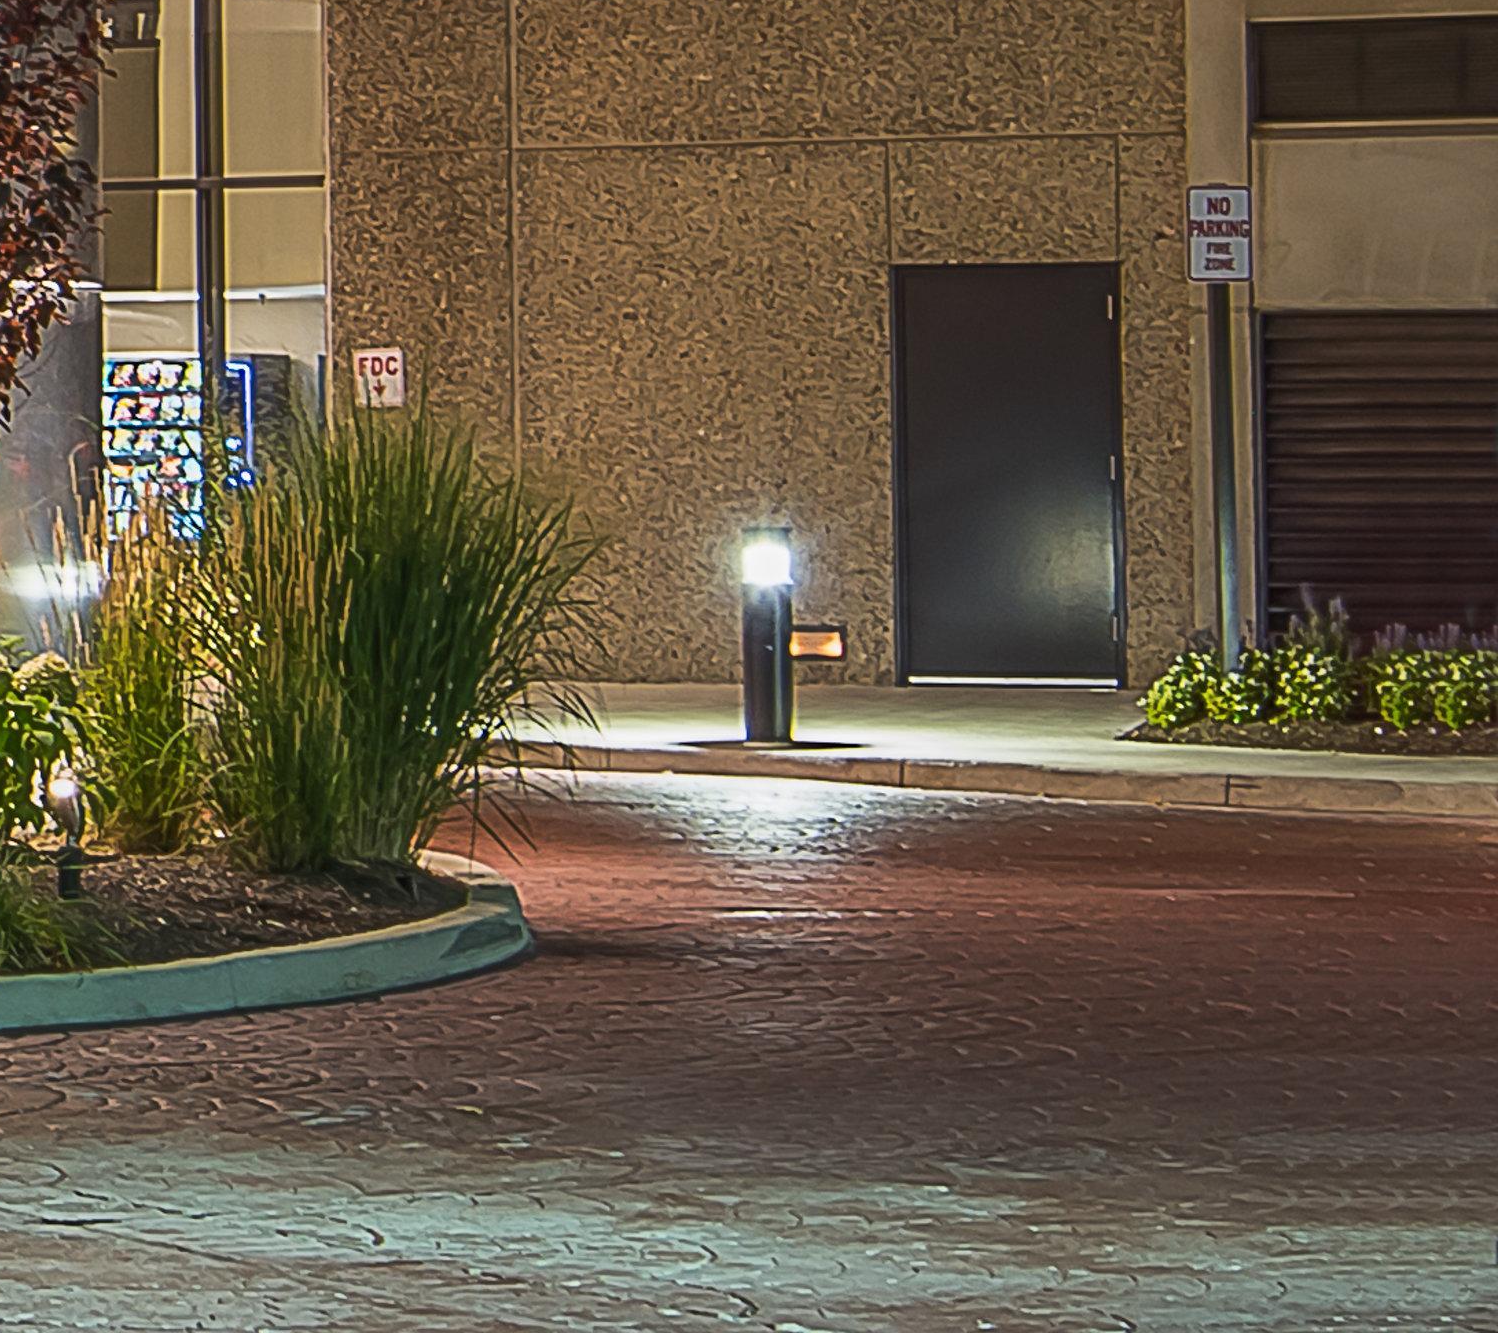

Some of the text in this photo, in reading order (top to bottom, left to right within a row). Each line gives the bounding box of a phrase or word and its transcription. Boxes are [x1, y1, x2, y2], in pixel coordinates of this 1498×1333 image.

[1206, 197, 1231, 216] NO
[1189, 220, 1250, 238] PARKING
[358, 356, 398, 376] FDC
